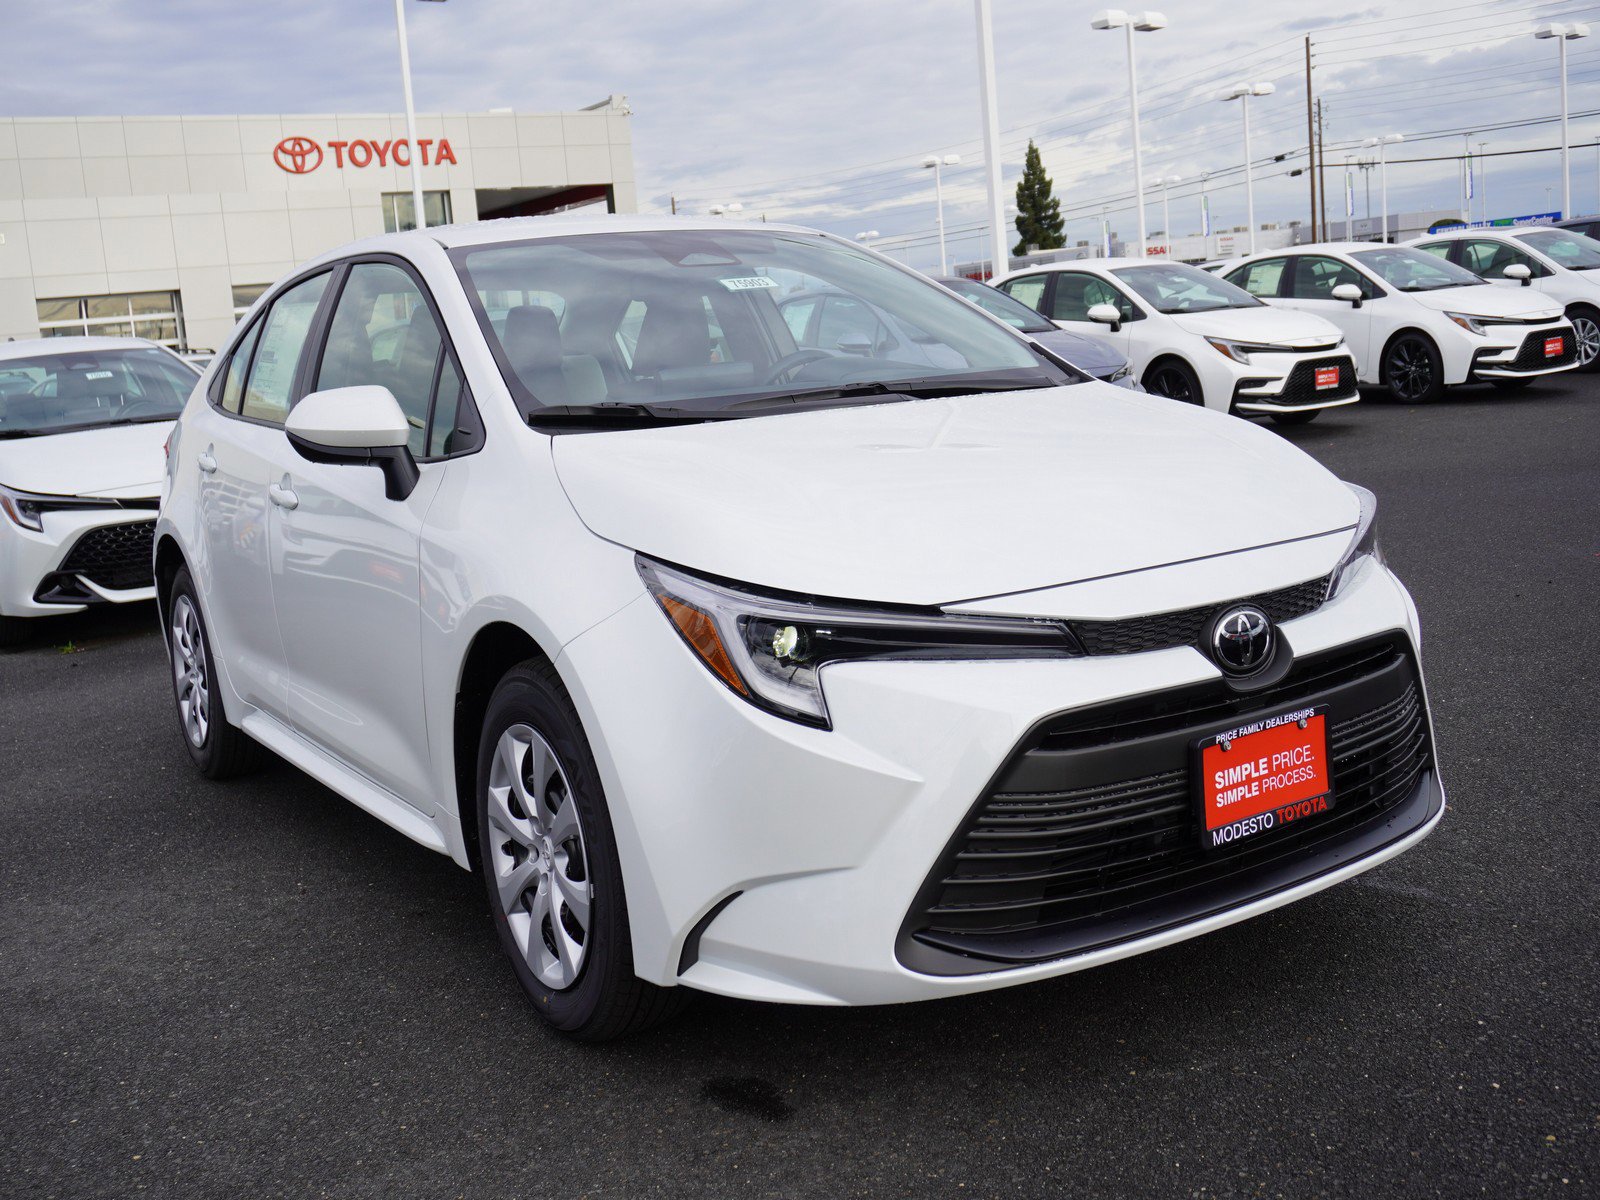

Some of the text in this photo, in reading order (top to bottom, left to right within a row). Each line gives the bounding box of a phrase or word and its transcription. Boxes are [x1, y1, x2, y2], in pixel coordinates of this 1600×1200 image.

[327, 138, 457, 168] TOYOTA
[1216, 709, 1314, 744] PRICE FAMILY DEALERSHIPS
[1215, 744, 1315, 789] SIMPLE PRICE.
[1216, 765, 1317, 807] SIMPLE PROCESS.
[1213, 796, 1327, 846] MODESTO TOYOTA
